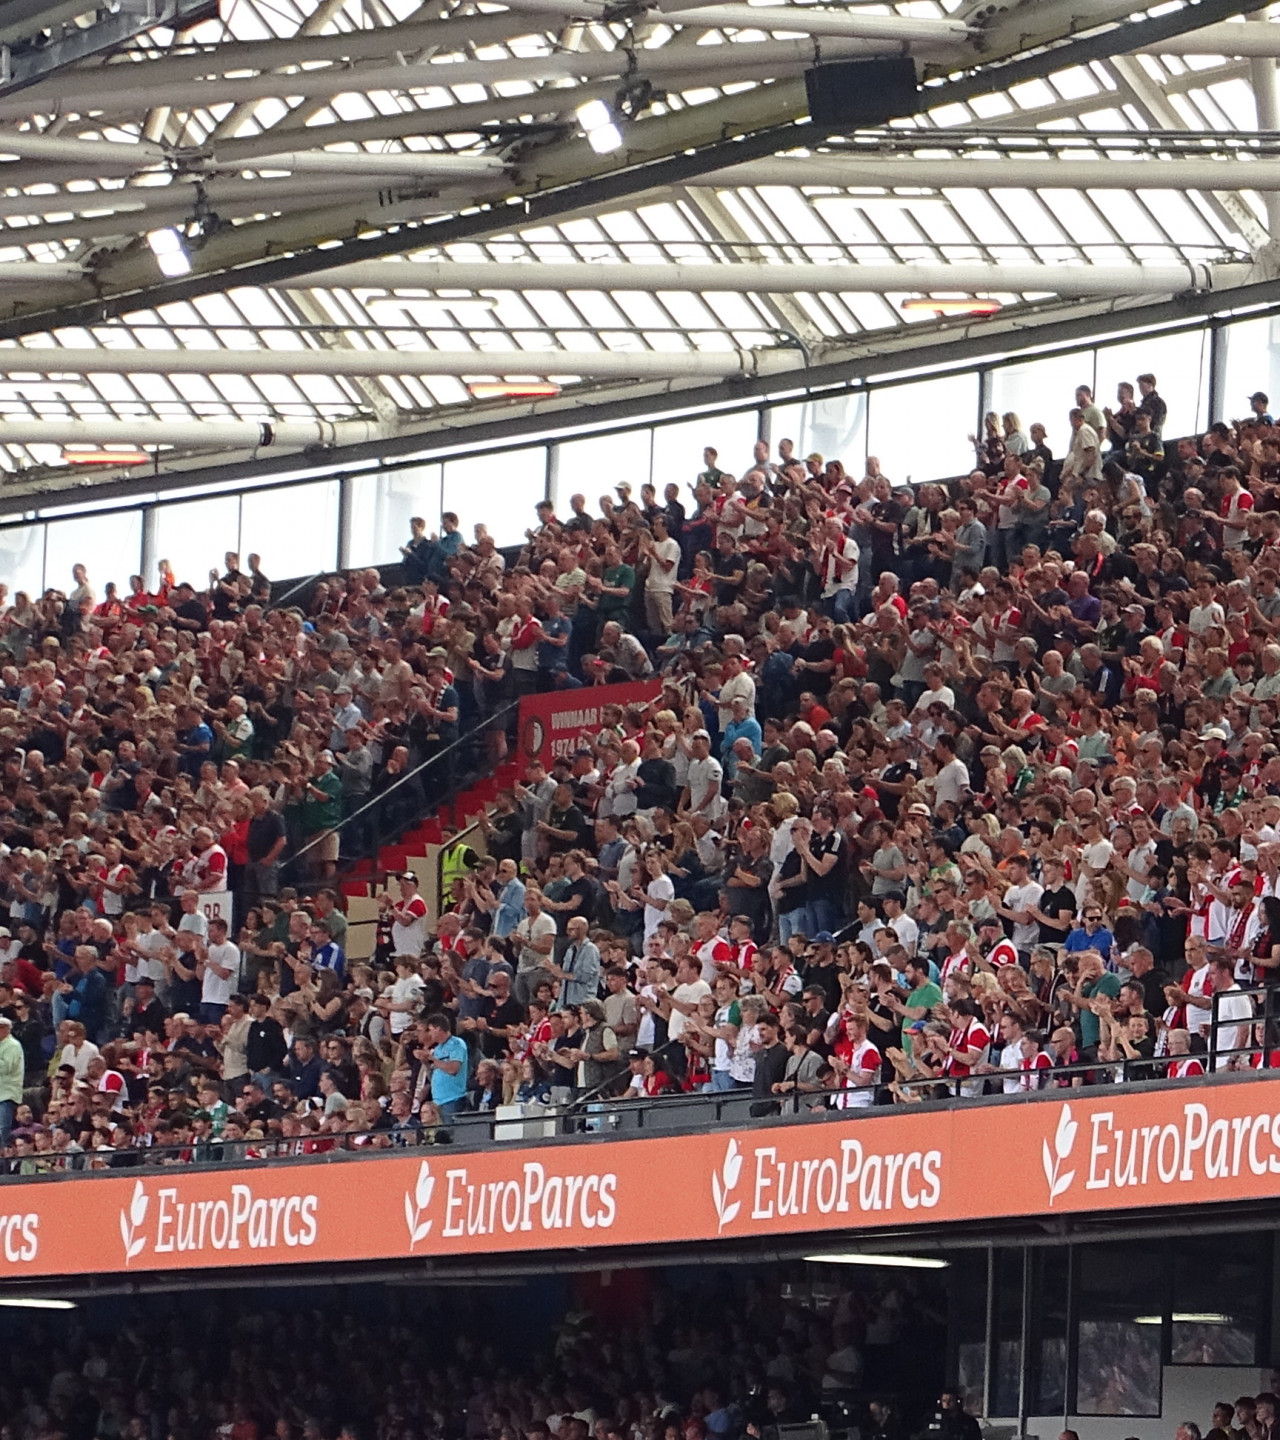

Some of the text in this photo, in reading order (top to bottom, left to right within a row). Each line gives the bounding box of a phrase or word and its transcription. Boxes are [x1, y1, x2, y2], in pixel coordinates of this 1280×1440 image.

[551, 708, 598, 730] WINNAAR
[442, 1162, 617, 1237] EuroParcs
[752, 1138, 942, 1220] EuroParcs
[154, 1184, 318, 1253] EuroParcs
